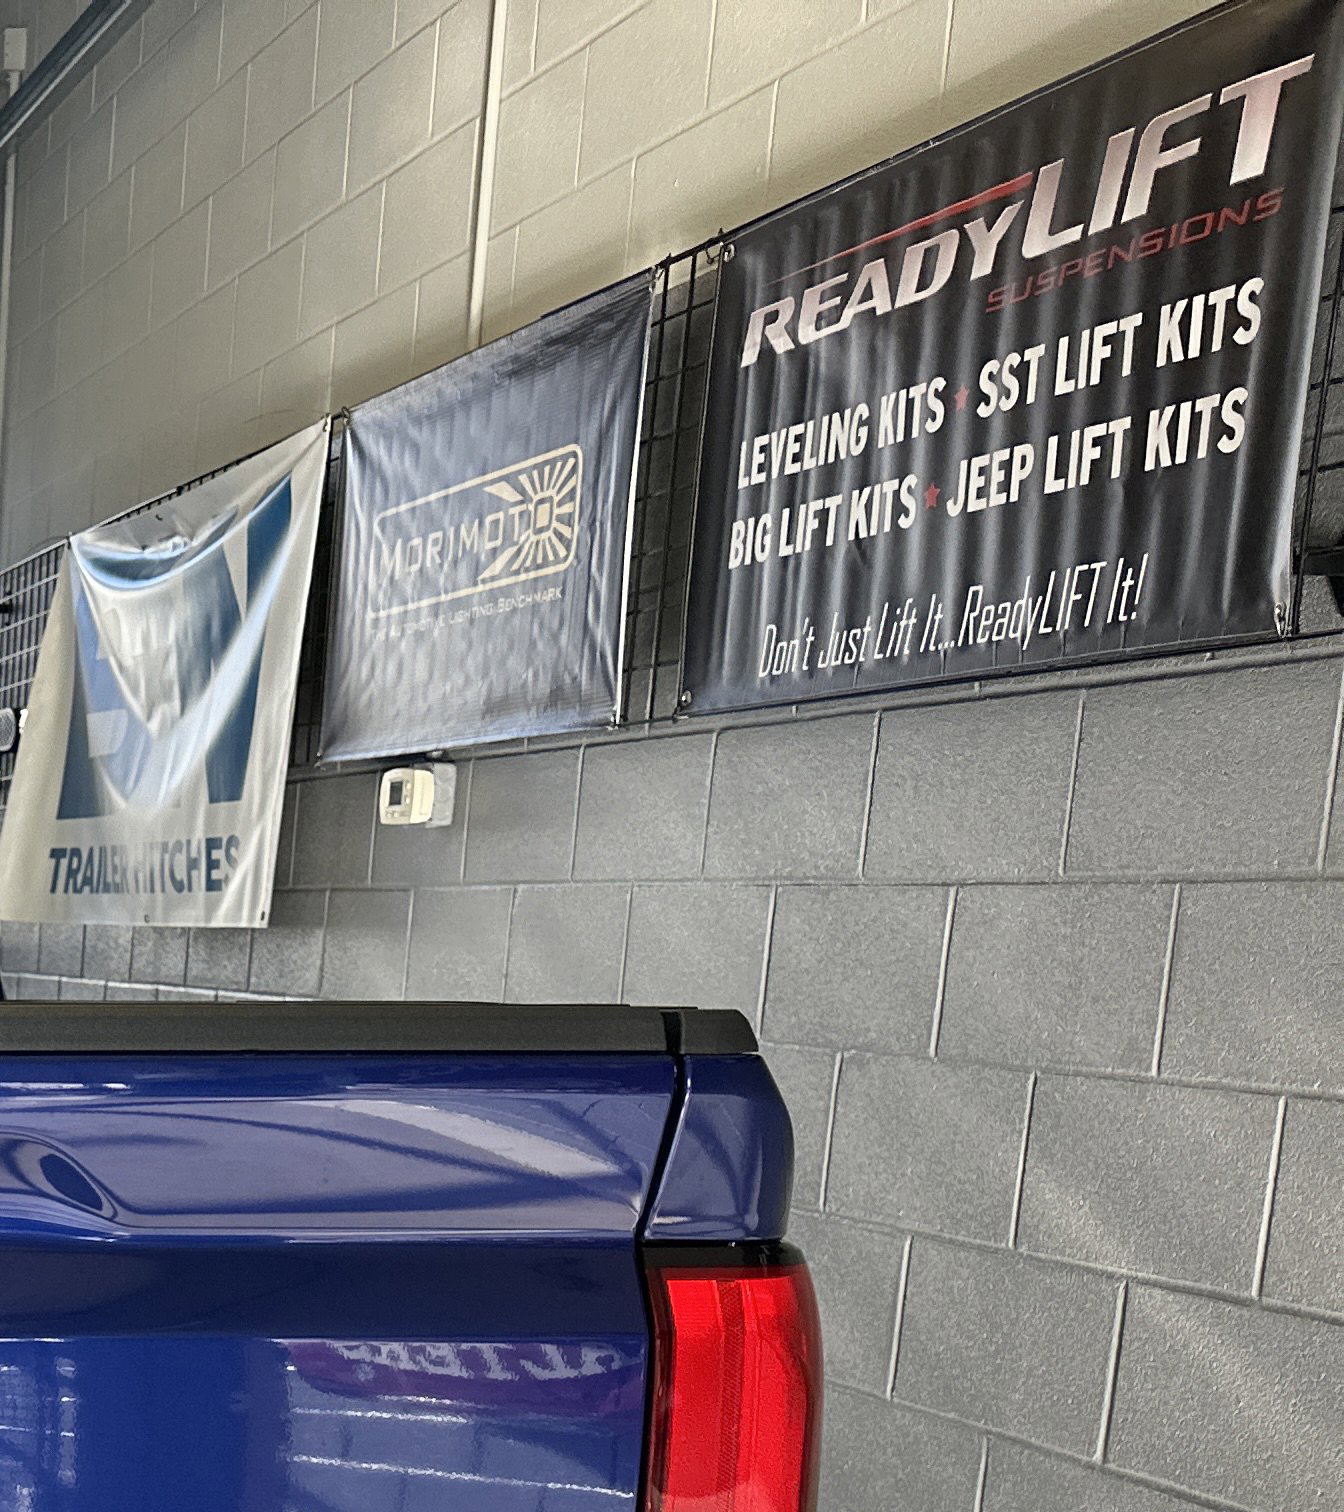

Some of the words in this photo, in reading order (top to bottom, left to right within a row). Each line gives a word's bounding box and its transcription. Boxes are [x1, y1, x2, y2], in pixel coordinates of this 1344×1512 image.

[740, 54, 1315, 369] READYLIFT
[985, 187, 1284, 313] SUSPENSIONS
[737, 399, 869, 490] LEVELING
[877, 376, 947, 450] KITS
[975, 343, 1046, 417] SST
[1053, 311, 1142, 399] LIFT
[1155, 277, 1265, 369] KITS
[728, 518, 771, 570] BIG
[778, 494, 844, 558] LIFT
[847, 473, 918, 542] KITS
[946, 442, 1034, 518] JEEP
[1043, 416, 1132, 496] LIFT
[1144, 386, 1248, 472] KITS
[497, 586, 563, 613] BENCHMARK
[758, 624, 815, 678] Don't
[817, 611, 872, 669] Just
[873, 598, 918, 660] Lift
[1106, 553, 1150, 624] It!
[49, 845, 129, 894] TRAILER
[133, 834, 240, 894] HITCHES
